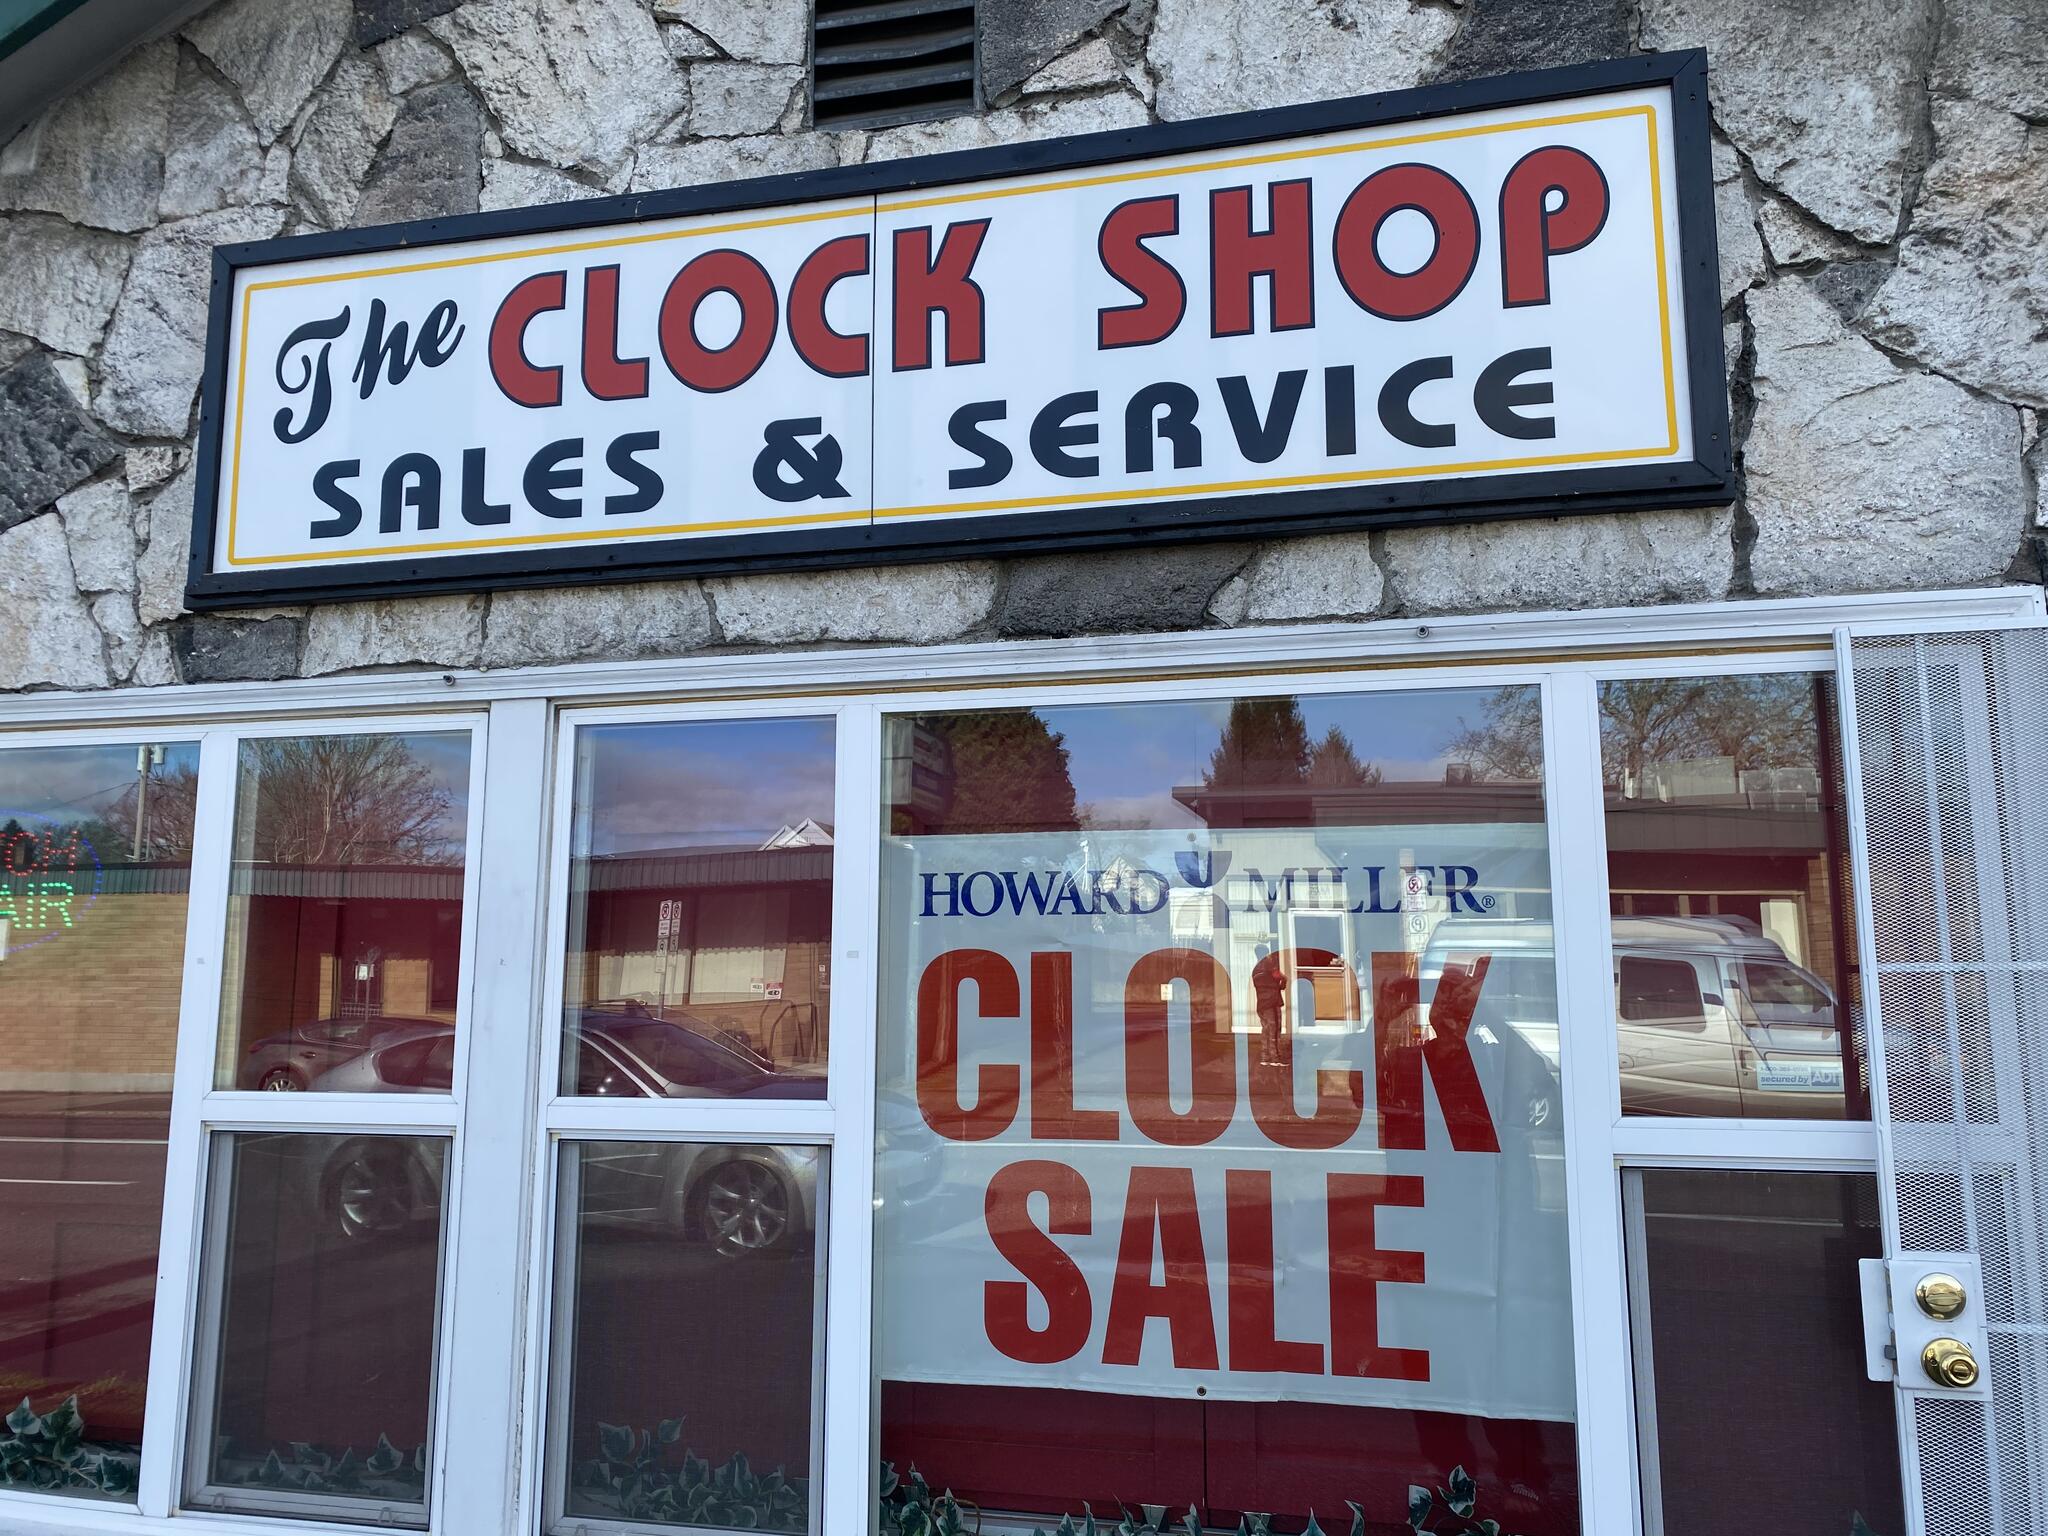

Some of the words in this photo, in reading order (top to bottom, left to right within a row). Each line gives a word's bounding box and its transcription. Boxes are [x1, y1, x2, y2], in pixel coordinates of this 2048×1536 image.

[273, 298, 465, 444] The
[488, 217, 992, 408] CLOCK
[1097, 145, 1610, 350] SHOP
[310, 430, 664, 539] SALES
[752, 416, 851, 503] &
[947, 346, 1556, 490] SERVICE
[919, 870, 1170, 917] HOWARD
[916, 948, 1501, 1152] CLOCK
[1760, 1074, 1797, 1083] secured
[1797, 1074, 1809, 1084] by
[984, 1159, 1430, 1381] SALE
